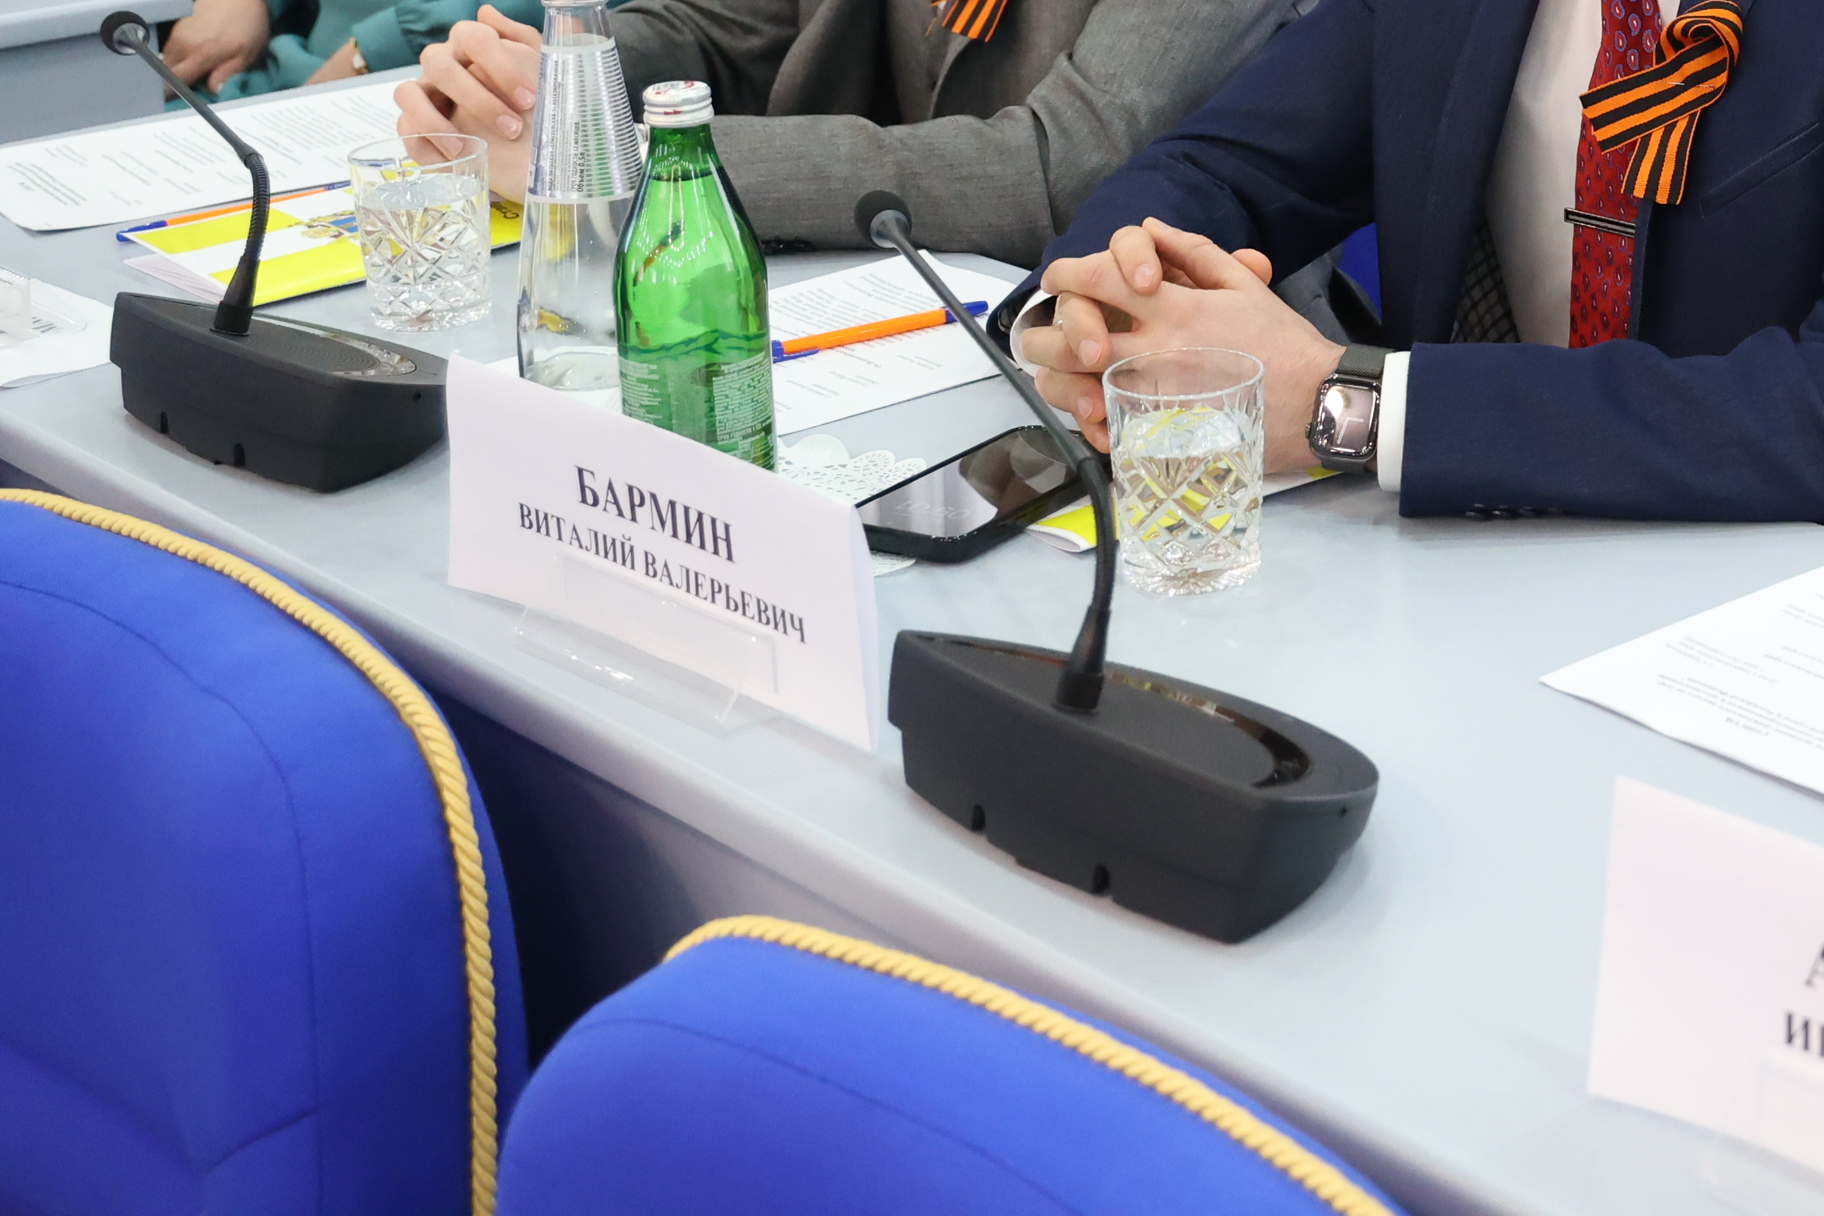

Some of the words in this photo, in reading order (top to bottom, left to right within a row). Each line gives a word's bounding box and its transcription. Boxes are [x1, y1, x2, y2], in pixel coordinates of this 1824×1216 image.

[577, 168, 586, 192] Объем
[574, 464, 736, 564] БАРМИН
[518, 501, 636, 572] ВИТАЛИЙ
[642, 550, 806, 644] ВАЛЕРЬЕВИЧ
